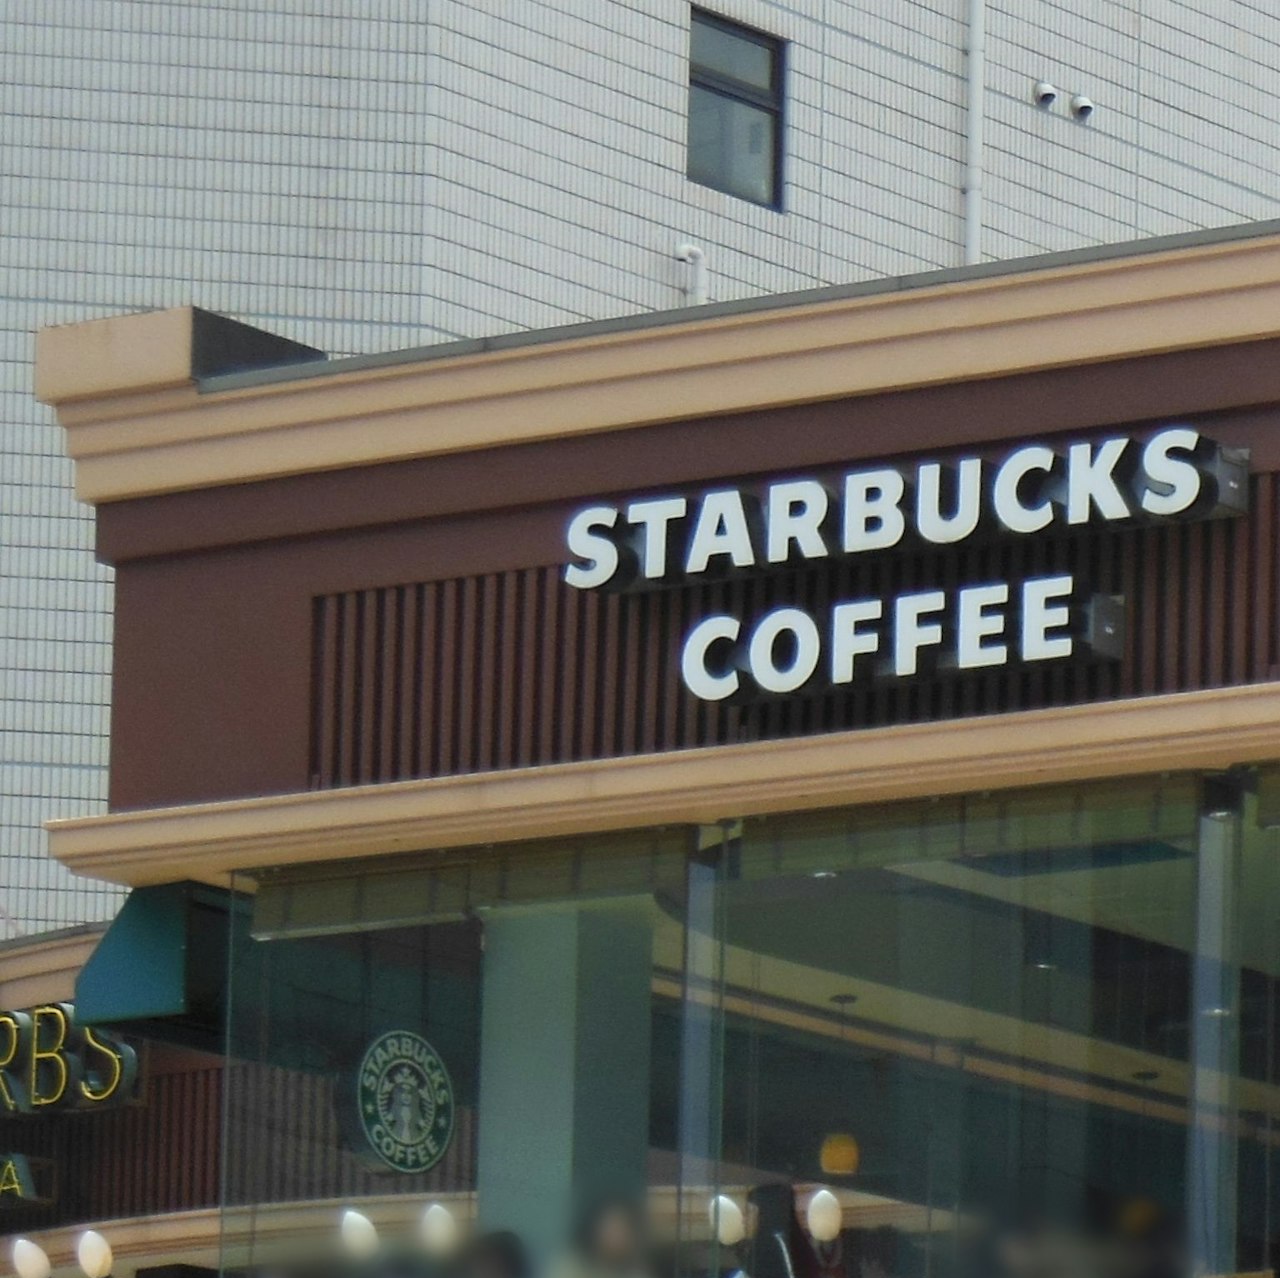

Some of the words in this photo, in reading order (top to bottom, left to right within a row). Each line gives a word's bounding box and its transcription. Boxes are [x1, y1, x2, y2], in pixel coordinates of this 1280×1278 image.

[564, 429, 1200, 590] STARBUCKS
[681, 575, 1073, 702] COFFEE
[363, 1036, 449, 1106] STARBUCKS
[371, 1122, 440, 1166] COFFEE
